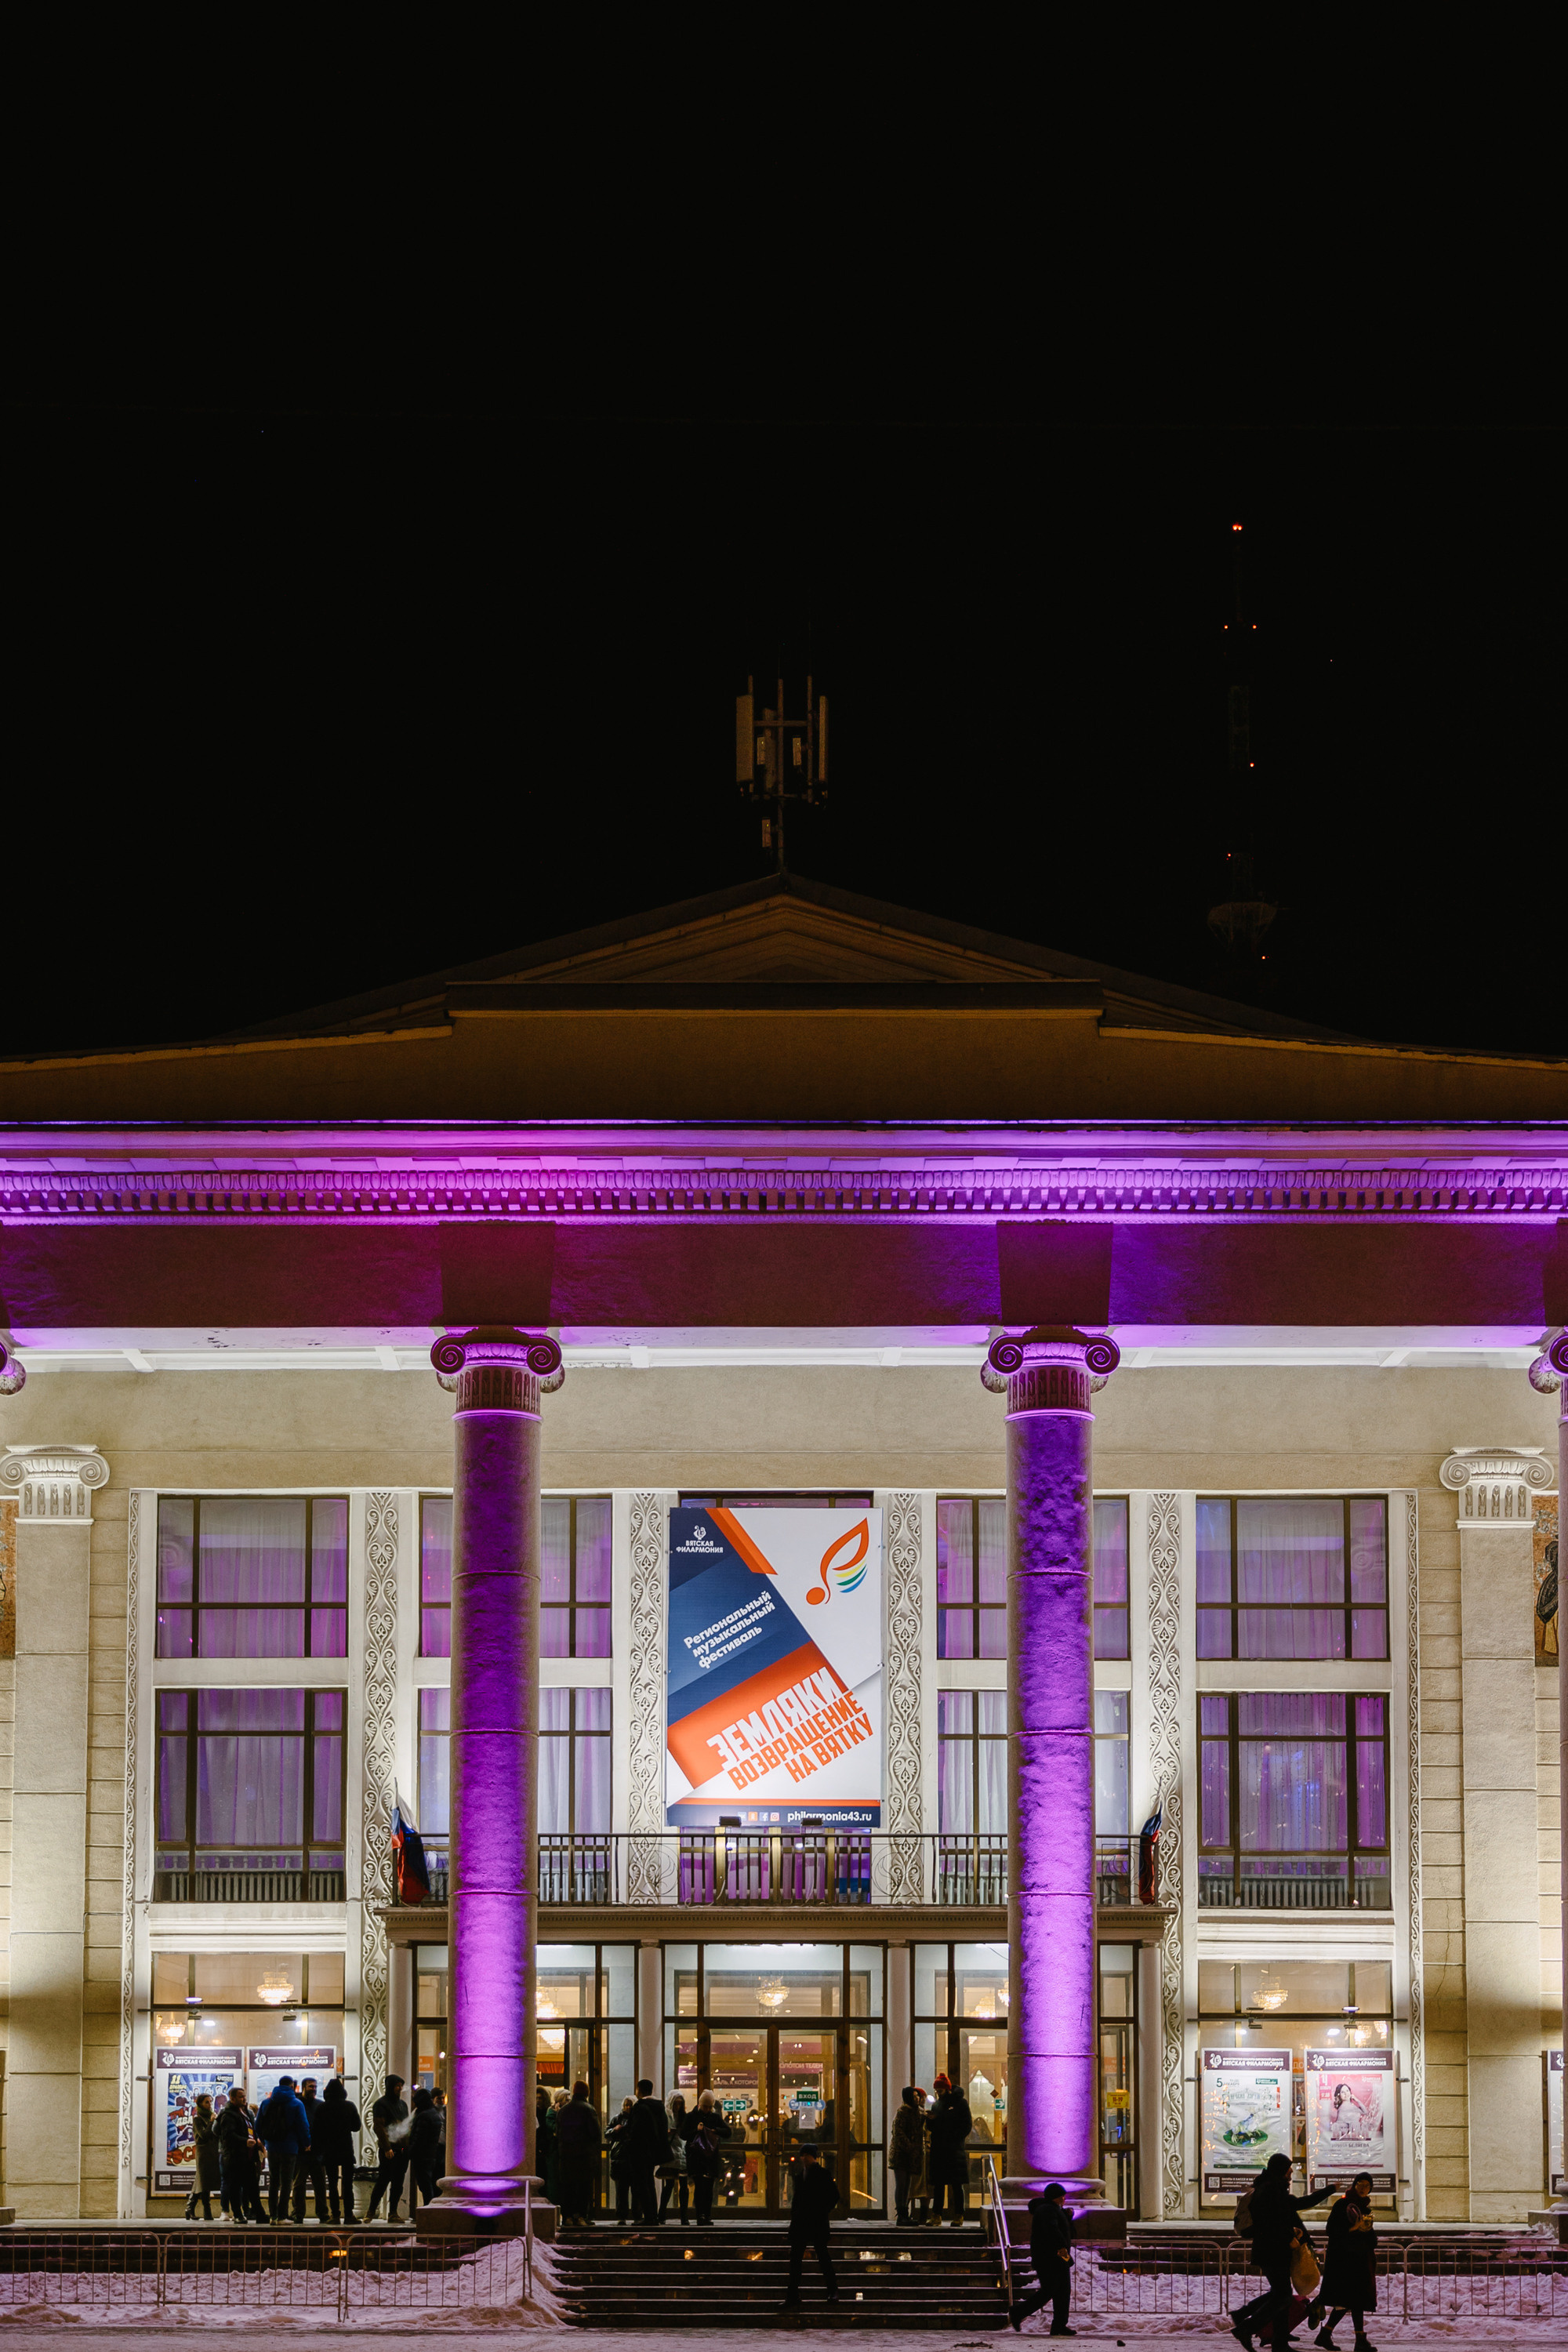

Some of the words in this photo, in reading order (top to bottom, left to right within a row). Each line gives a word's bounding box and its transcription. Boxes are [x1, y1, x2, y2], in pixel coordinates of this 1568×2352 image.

[684, 1590, 771, 1650] Региональный
[692, 1601, 776, 1658] музыкальный
[699, 1624, 763, 1669] фестиваль
[706, 1666, 842, 1770] ЗЕМЛЯКИ
[728, 1690, 864, 1791] ВОЗВРАЩЕНИЕ
[785, 1759, 816, 1783] НА
[813, 1712, 874, 1771] ВЯТКУ
[787, 1811, 872, 1823] philarmonia43.ru
[1216, 2078, 1223, 2088] 5
